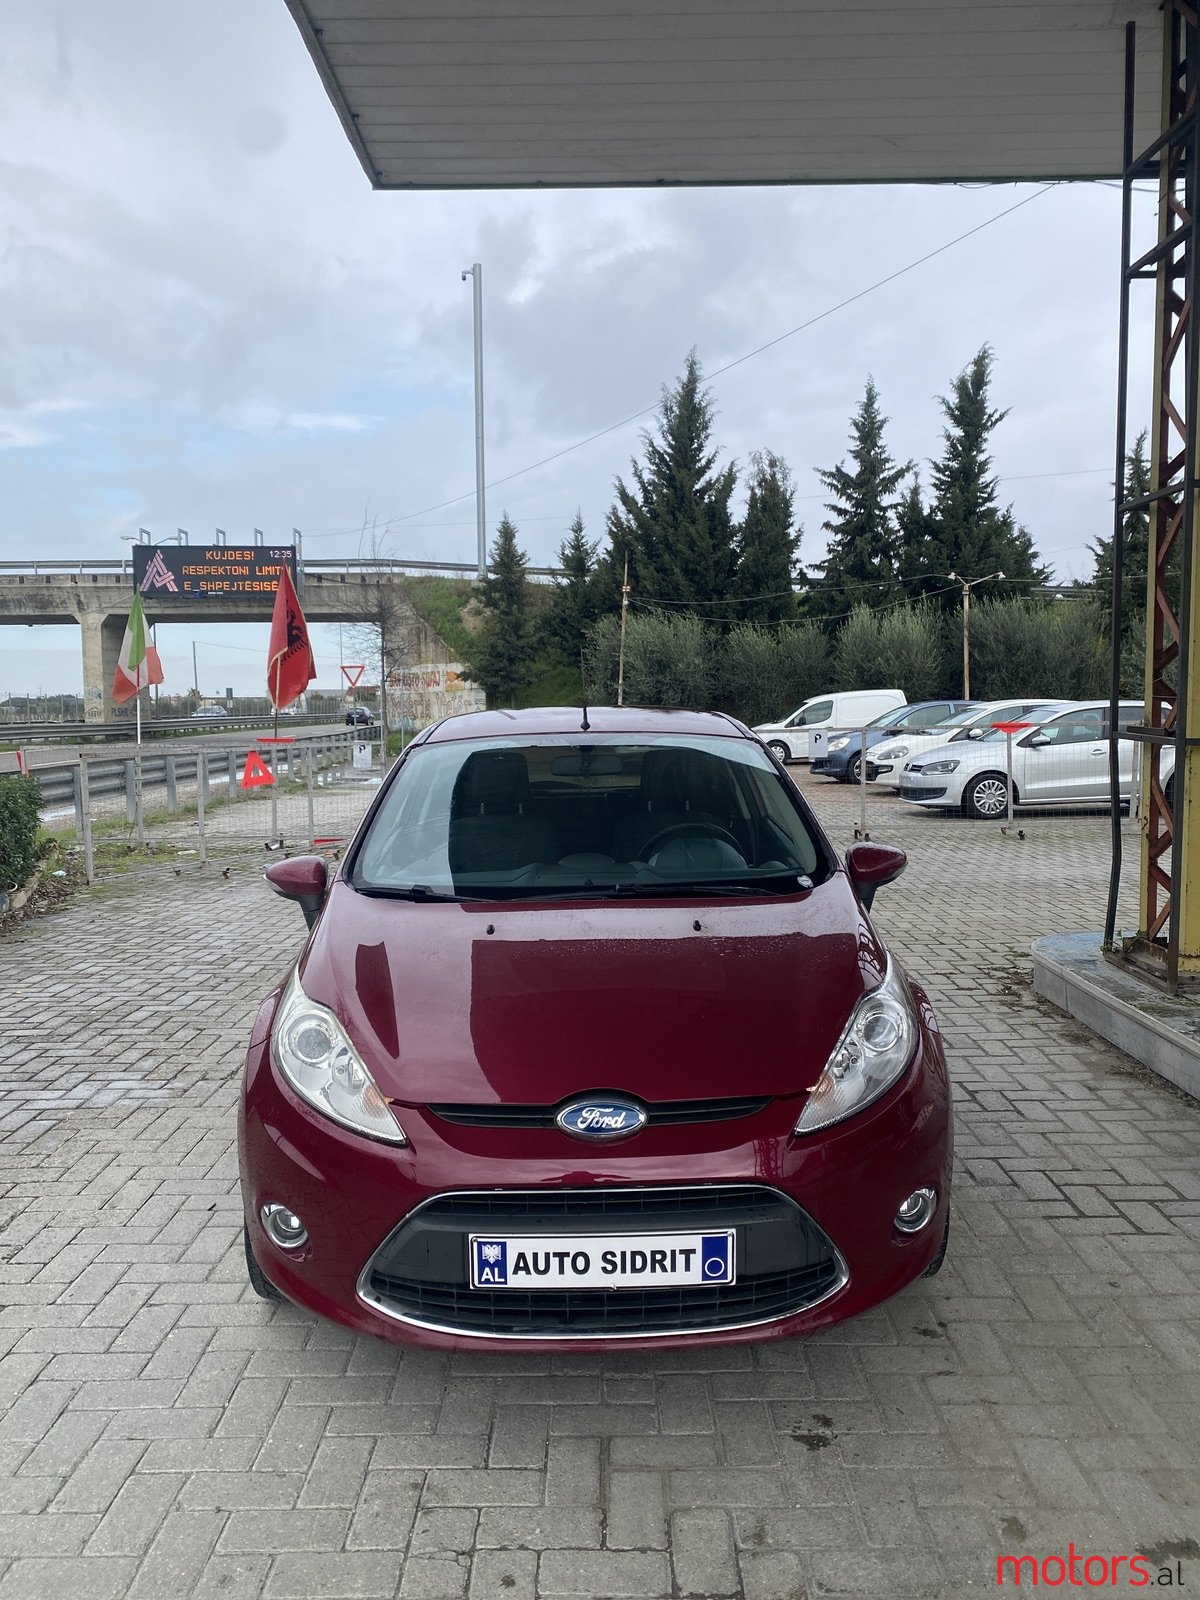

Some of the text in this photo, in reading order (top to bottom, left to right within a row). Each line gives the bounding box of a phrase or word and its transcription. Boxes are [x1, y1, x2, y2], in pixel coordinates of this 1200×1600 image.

[205, 550, 255, 560] KUJDES!
[269, 550, 292, 558] 12:35
[182, 565, 291, 576] RESPEKTONI LIMIT
[184, 581, 192, 591] E
[815, 734, 822, 743] P
[359, 745, 366, 753] P
[577, 1107, 626, 1129] Ford
[512, 1249, 696, 1276] AUTO SIDRIT
[481, 1267, 505, 1282] AL
